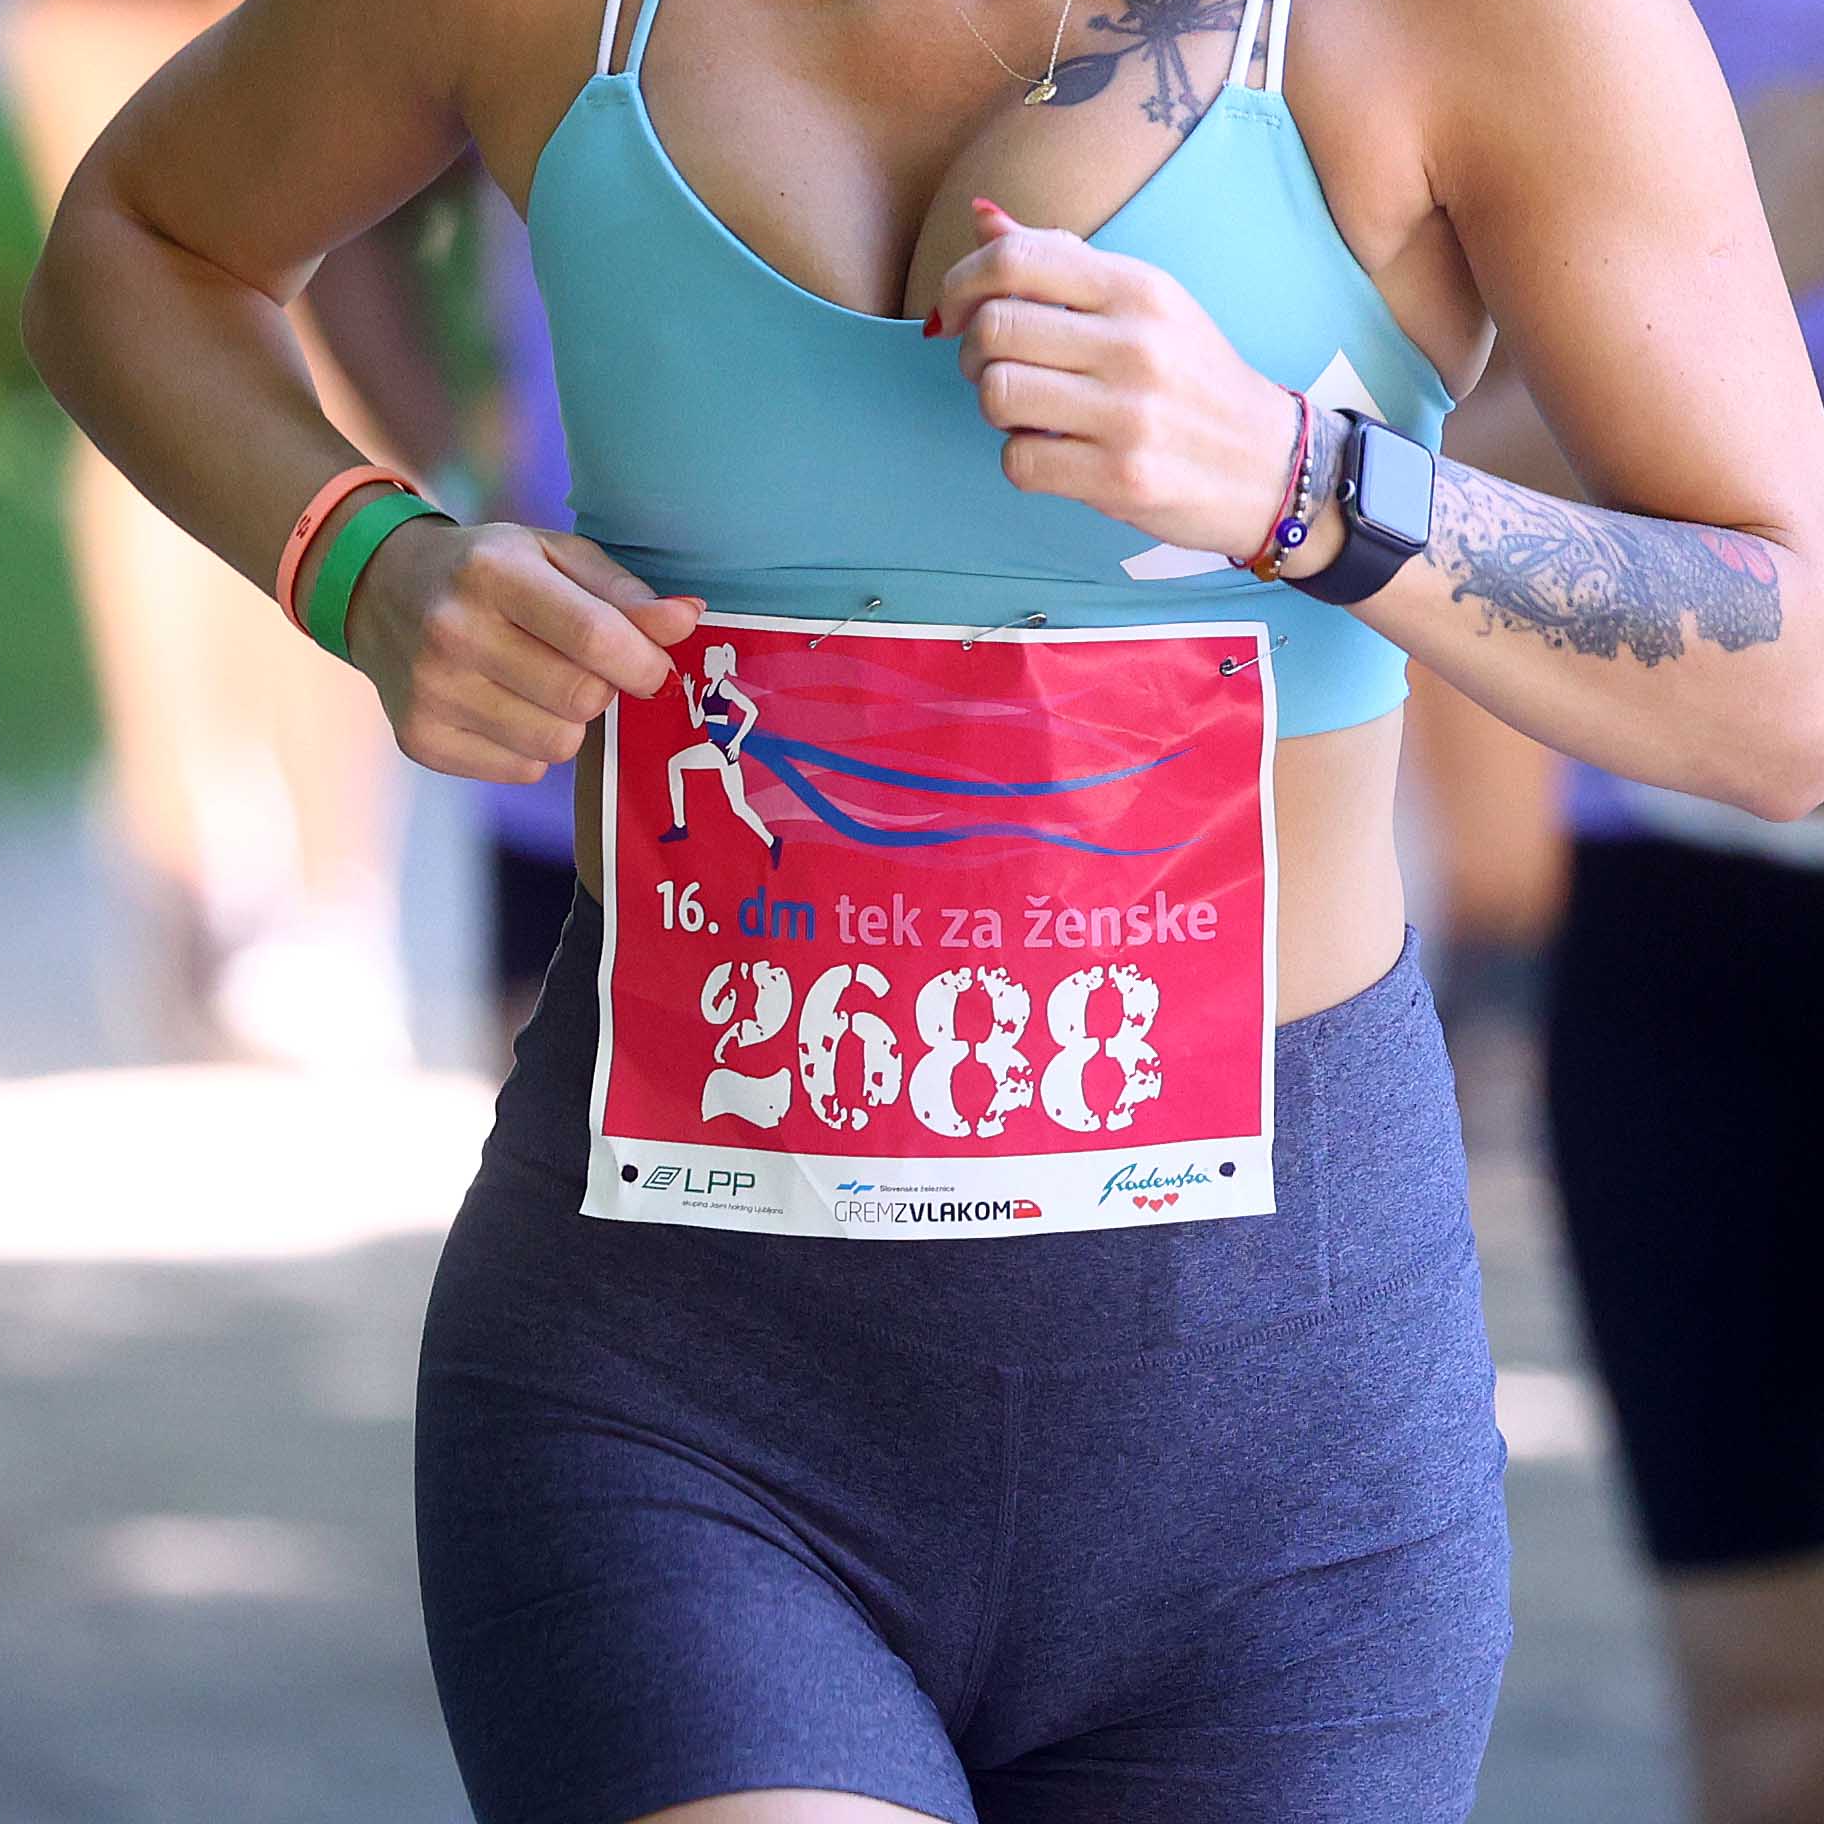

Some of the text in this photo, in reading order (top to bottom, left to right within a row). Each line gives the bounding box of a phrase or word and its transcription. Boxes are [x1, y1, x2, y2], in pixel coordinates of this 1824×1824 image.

[656, 880, 1218, 949] 16. dm tek za ženske
[700, 960, 1164, 1139] 2688
[684, 1168, 756, 1196] LPP
[1097, 1162, 1212, 1206] Radenska
